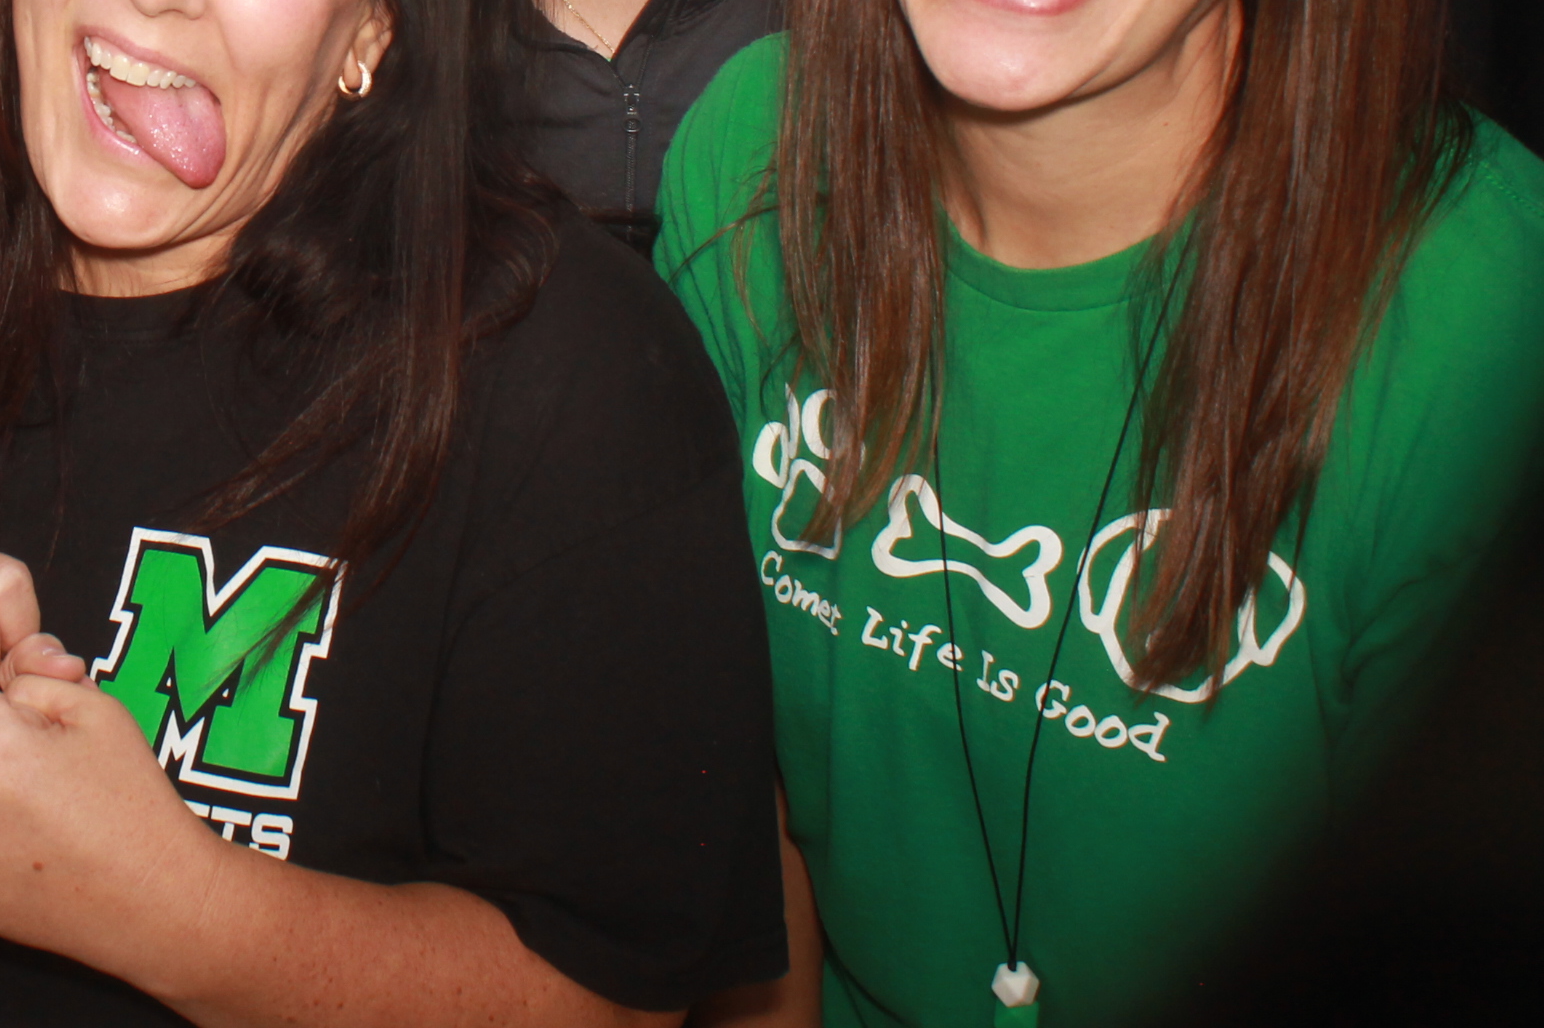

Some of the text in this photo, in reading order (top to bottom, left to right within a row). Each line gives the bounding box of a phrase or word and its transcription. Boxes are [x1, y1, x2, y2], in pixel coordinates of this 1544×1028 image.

[90, 525, 349, 801] M
[760, 549, 1173, 764] Comet Life Is Good
